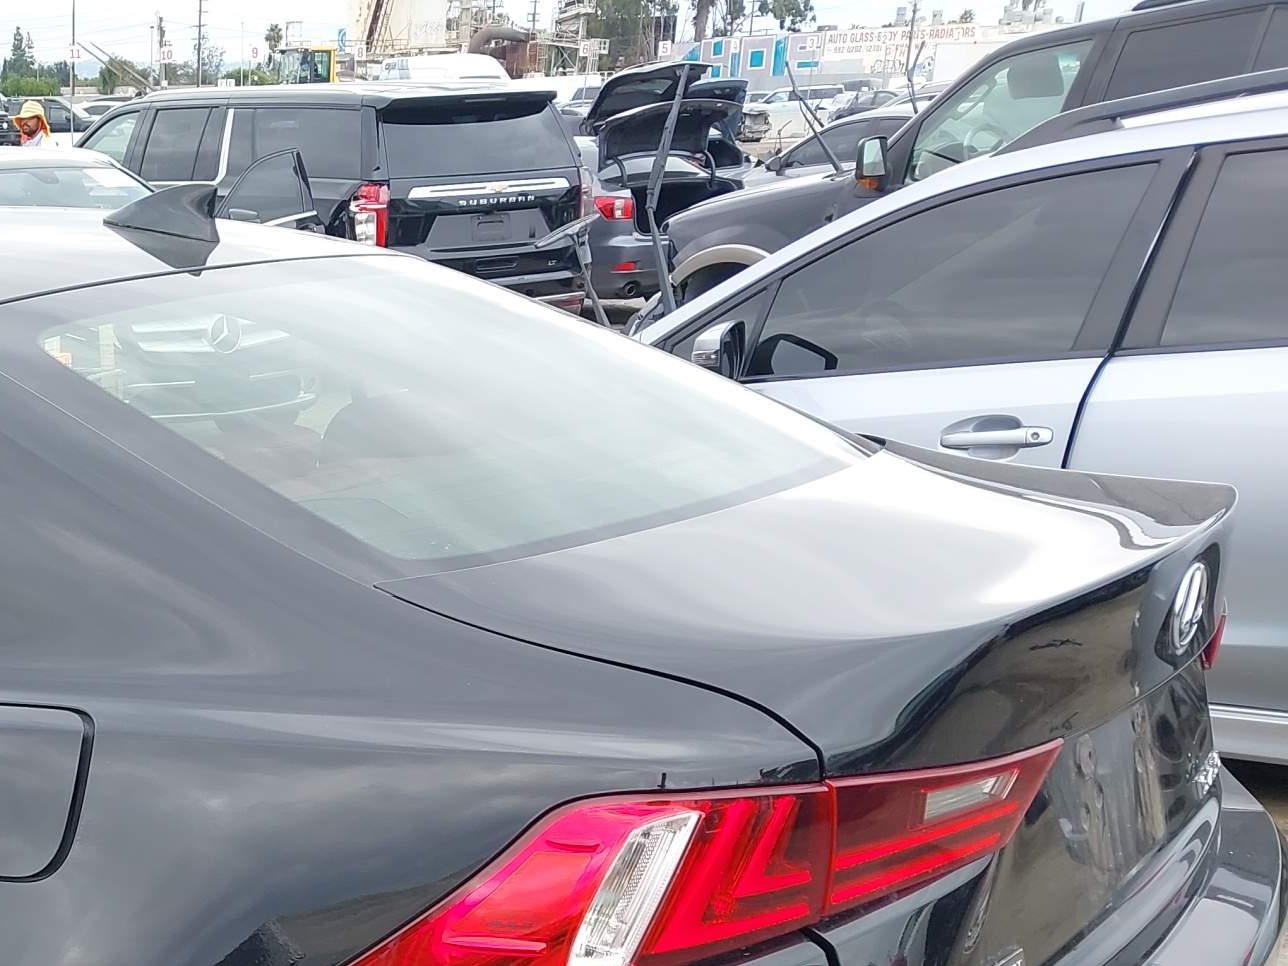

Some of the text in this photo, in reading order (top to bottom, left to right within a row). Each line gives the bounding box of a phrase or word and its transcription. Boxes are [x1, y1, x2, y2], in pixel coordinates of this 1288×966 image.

[828, 34, 848, 44] AUTO
[850, 32, 874, 43] GLASS
[252, 47, 259, 58] 9
[582, 43, 589, 54] 6
[661, 43, 669, 54] 5
[161, 50, 173, 60] 10
[459, 195, 535, 206] SUBURBAN
